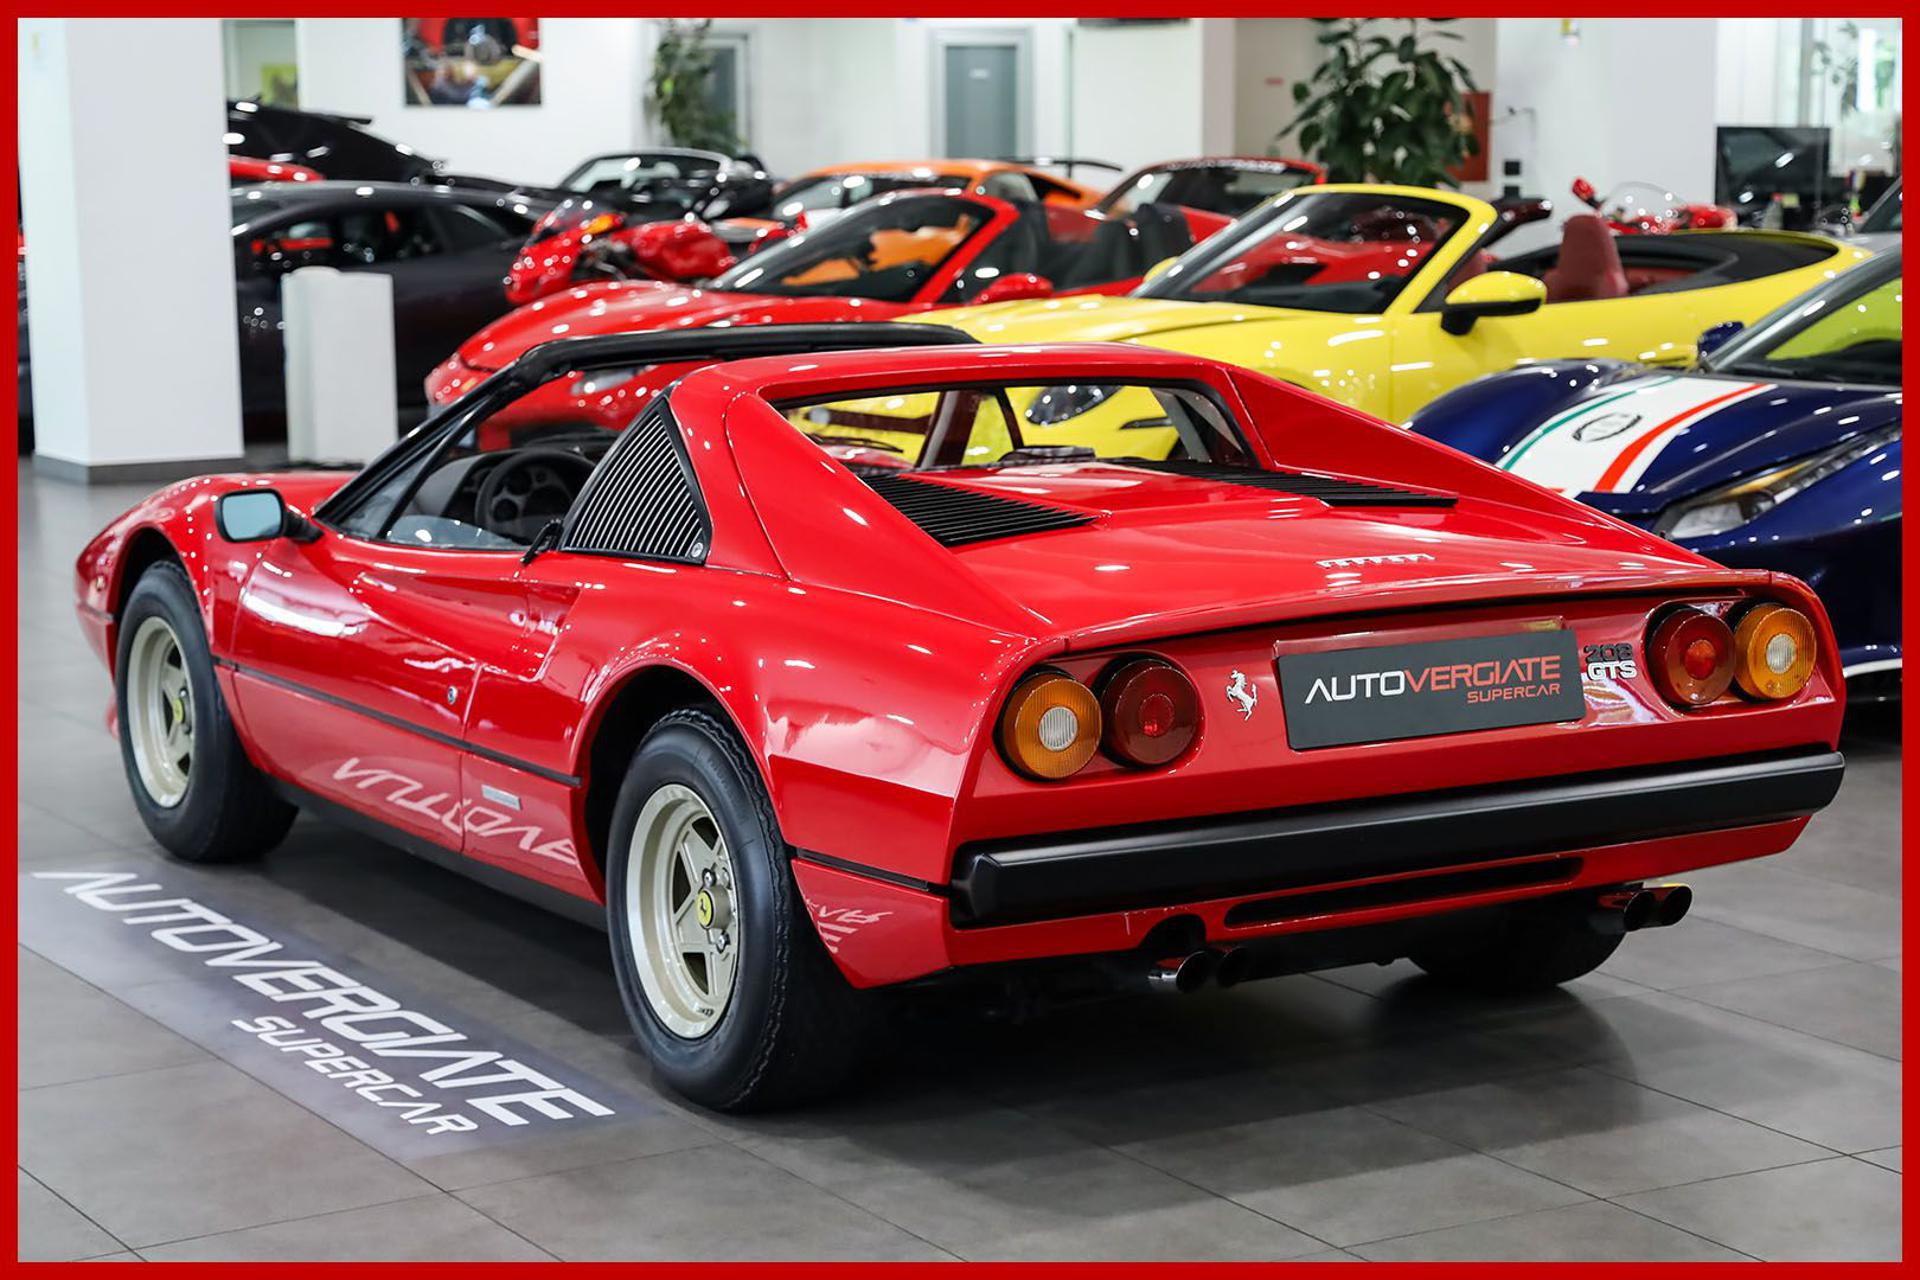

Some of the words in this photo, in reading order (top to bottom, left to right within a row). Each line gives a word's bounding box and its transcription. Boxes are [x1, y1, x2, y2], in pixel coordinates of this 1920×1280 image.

[1583, 643, 1633, 663] 208
[1586, 660, 1637, 680] GTS
[1304, 655, 1561, 704] AUTOVERGIATE
[1466, 683, 1561, 704] SUPERCAR
[31, 871, 616, 1125] AUTOVERGIATE
[231, 1015, 479, 1135] SUPERCAR
